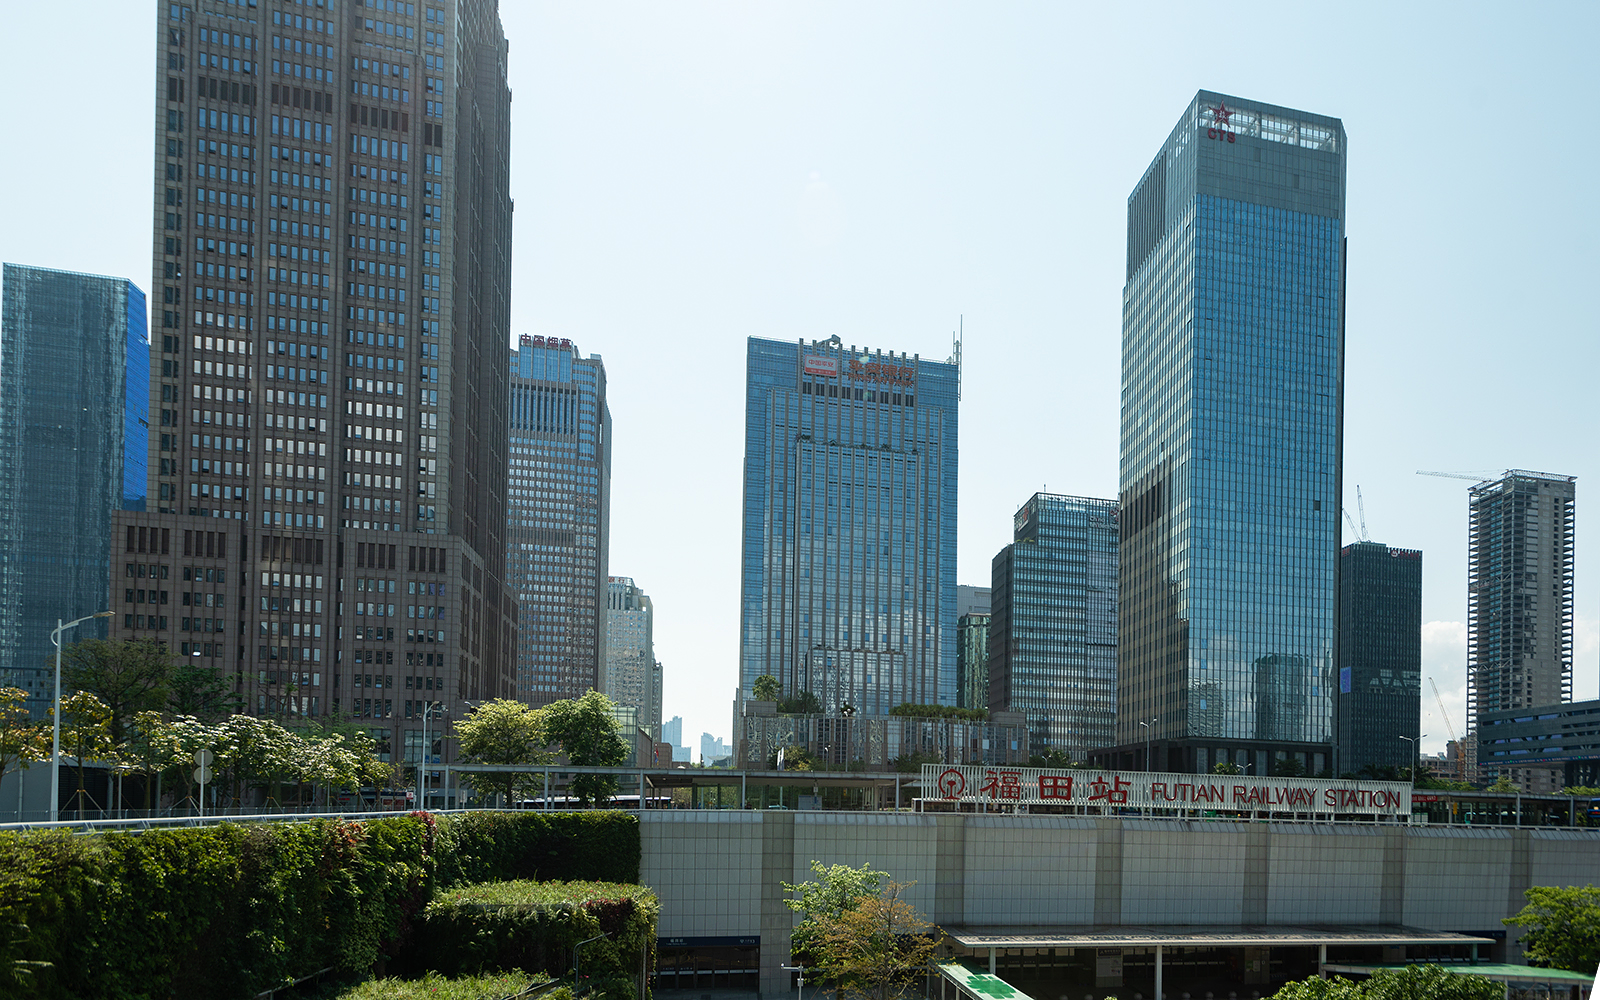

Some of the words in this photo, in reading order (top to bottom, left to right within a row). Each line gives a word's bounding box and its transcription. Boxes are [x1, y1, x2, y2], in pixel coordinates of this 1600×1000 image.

[1208, 128, 1236, 143] CTS
[849, 360, 914, 378] 平安银行
[980, 770, 1132, 804] 福田站
[1151, 783, 1225, 803] FUTIAN
[1233, 786, 1317, 806] RAILWAY
[1324, 788, 1400, 808] STATION
